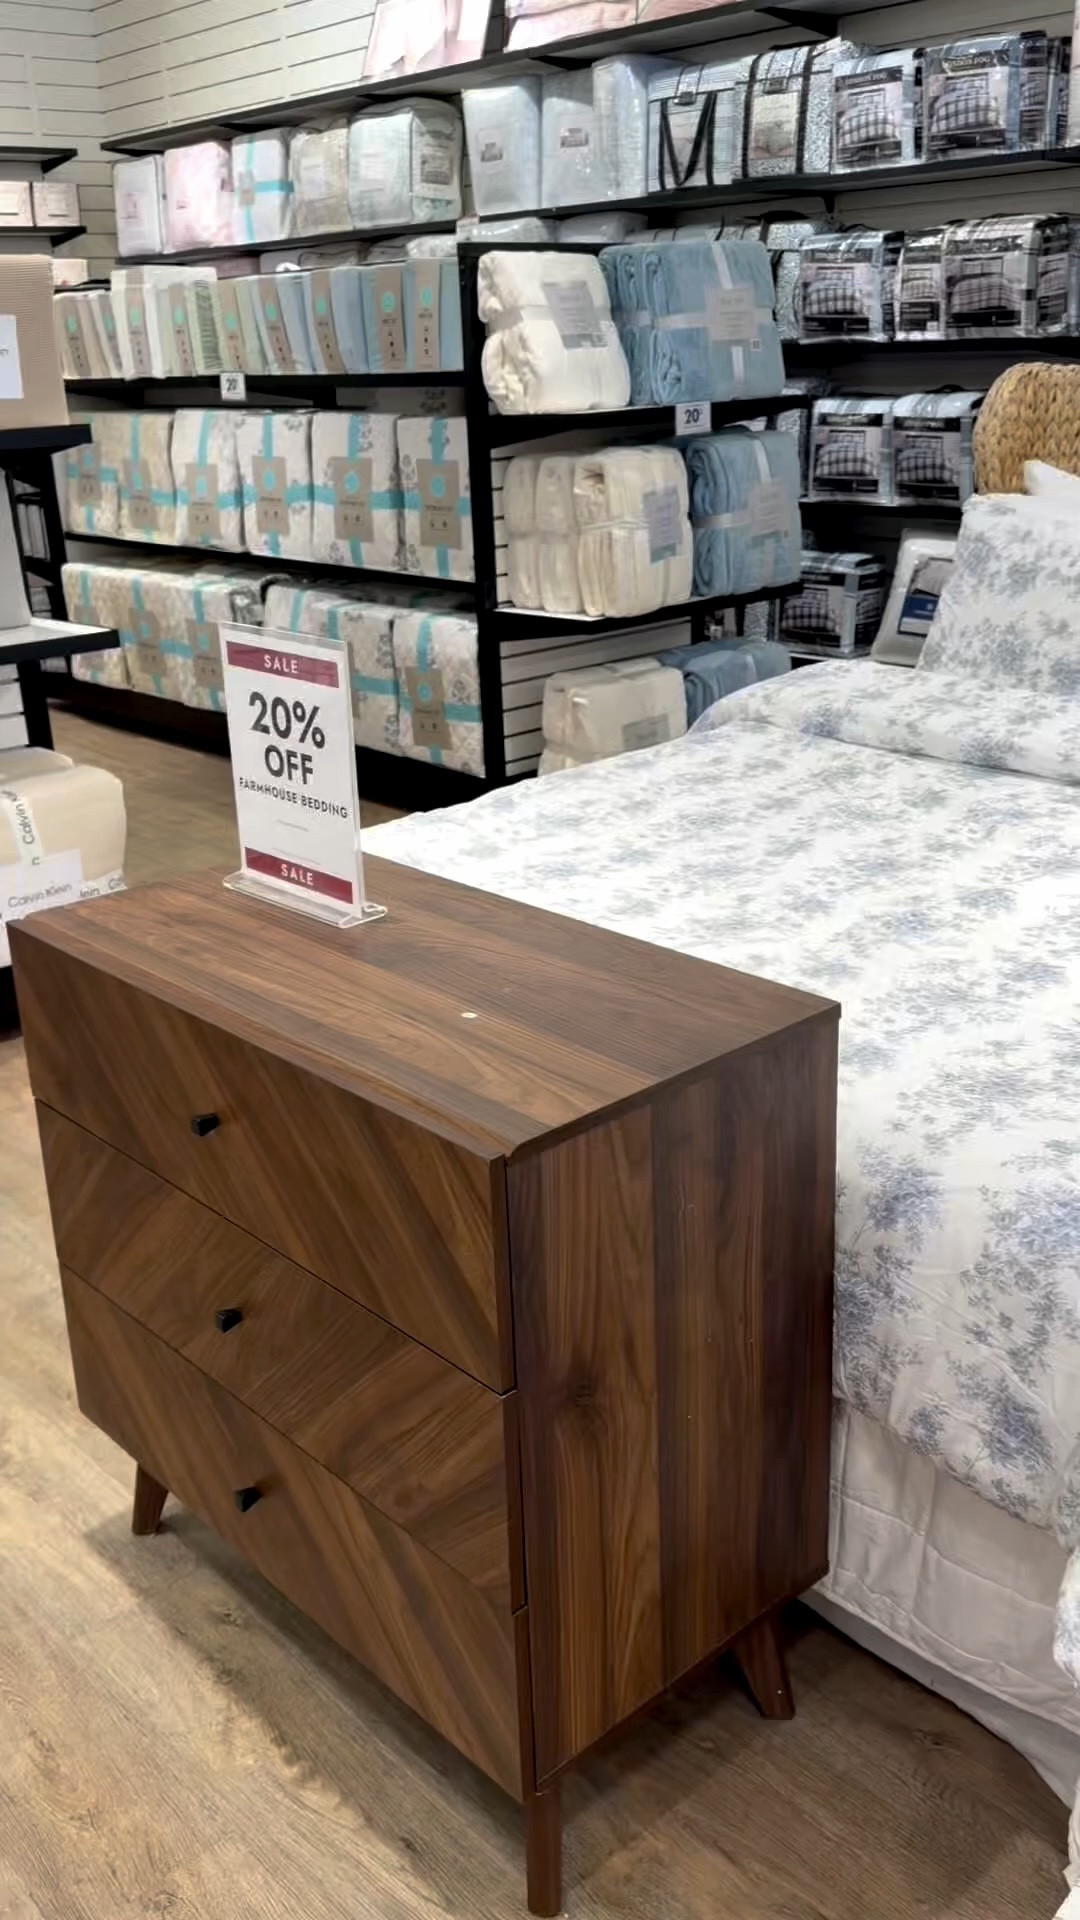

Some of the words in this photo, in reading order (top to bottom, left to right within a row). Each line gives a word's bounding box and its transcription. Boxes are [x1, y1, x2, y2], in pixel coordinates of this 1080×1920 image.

[264, 654, 299, 674] SALE
[248, 691, 326, 749] 20%
[264, 744, 314, 785] OFF
[239, 776, 298, 804] FARMHOUSE
[301, 795, 348, 819] BEDDING
[281, 863, 314, 886] SALE
[8, 890, 45, 908] Calvin
